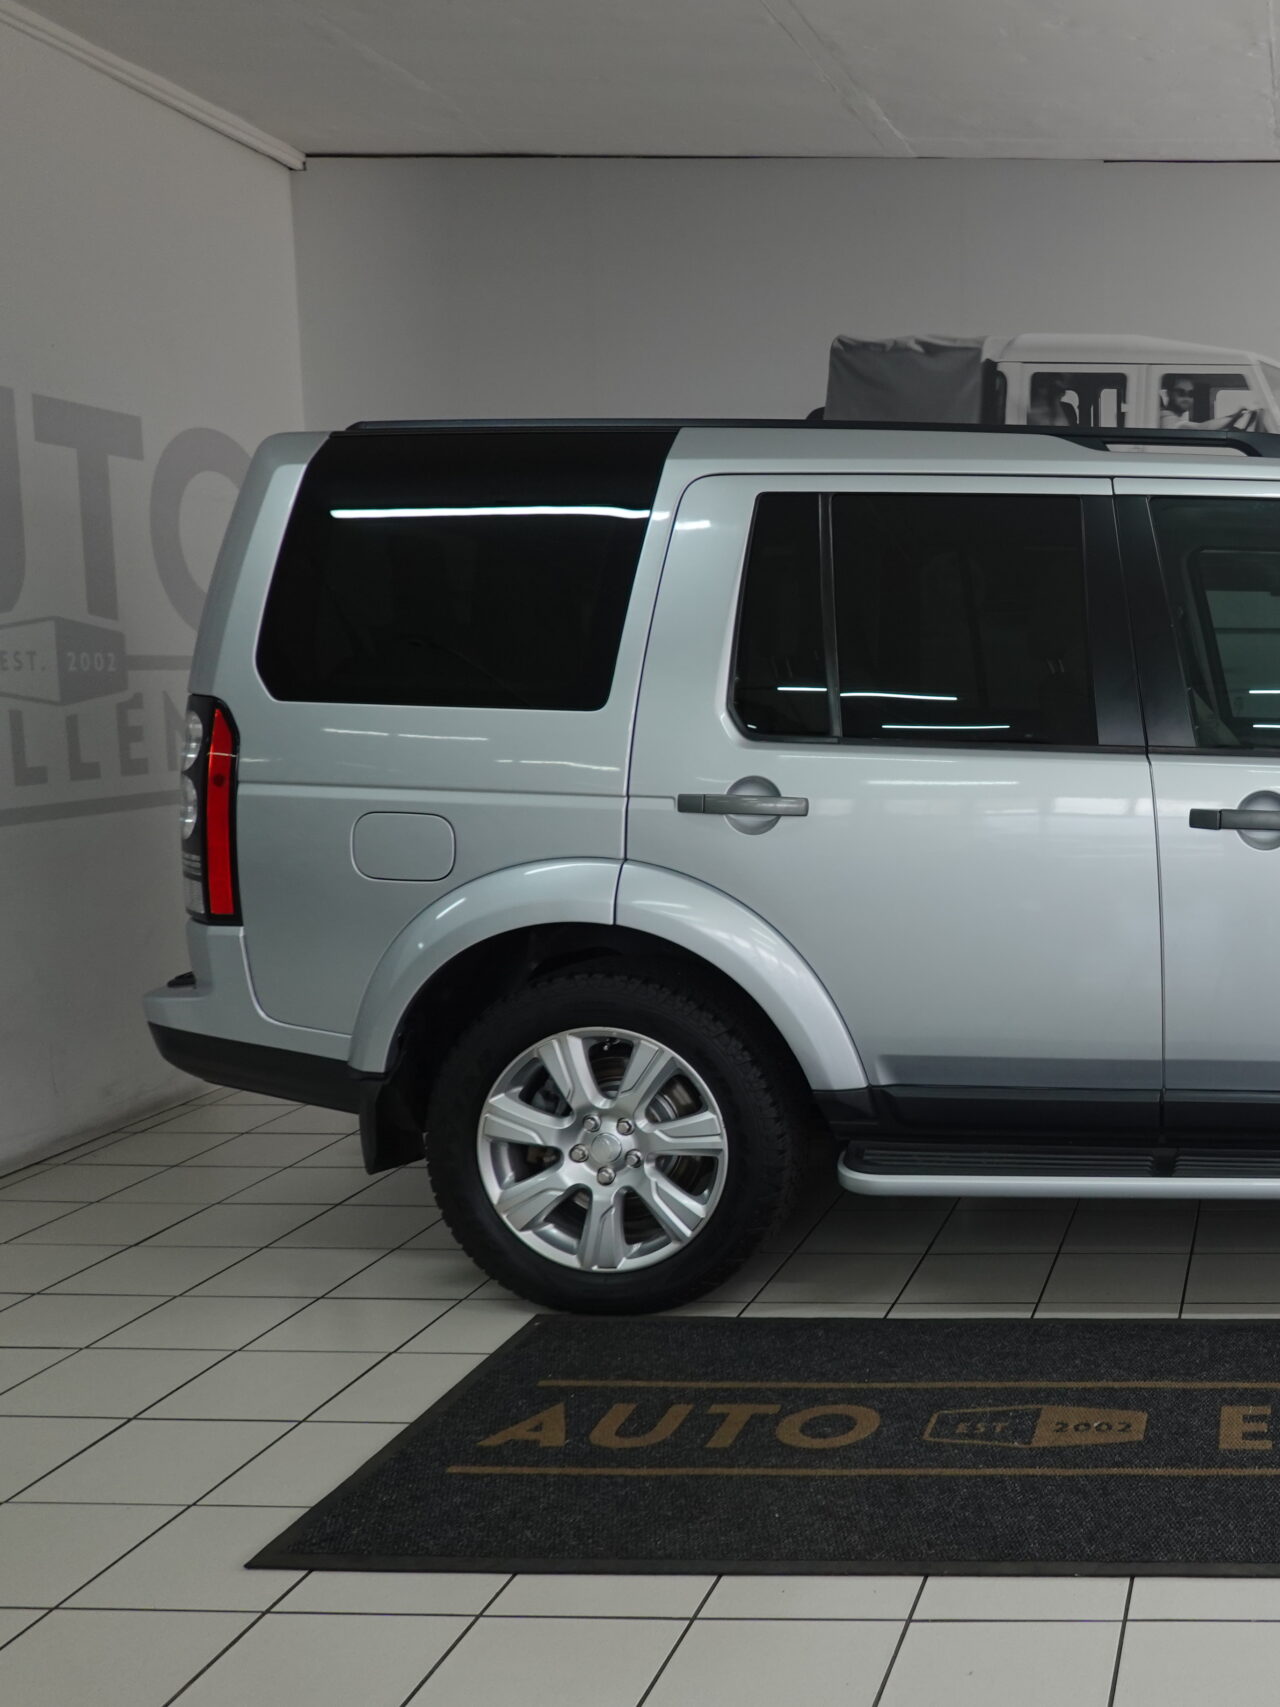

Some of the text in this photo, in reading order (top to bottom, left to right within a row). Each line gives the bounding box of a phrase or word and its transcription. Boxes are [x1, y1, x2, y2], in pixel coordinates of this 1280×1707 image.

[0, 386, 251, 632] TO
[67, 651, 117, 672] 2002
[476, 1402, 880, 1450] AUTO
[1055, 1421, 1133, 1434] 2002
